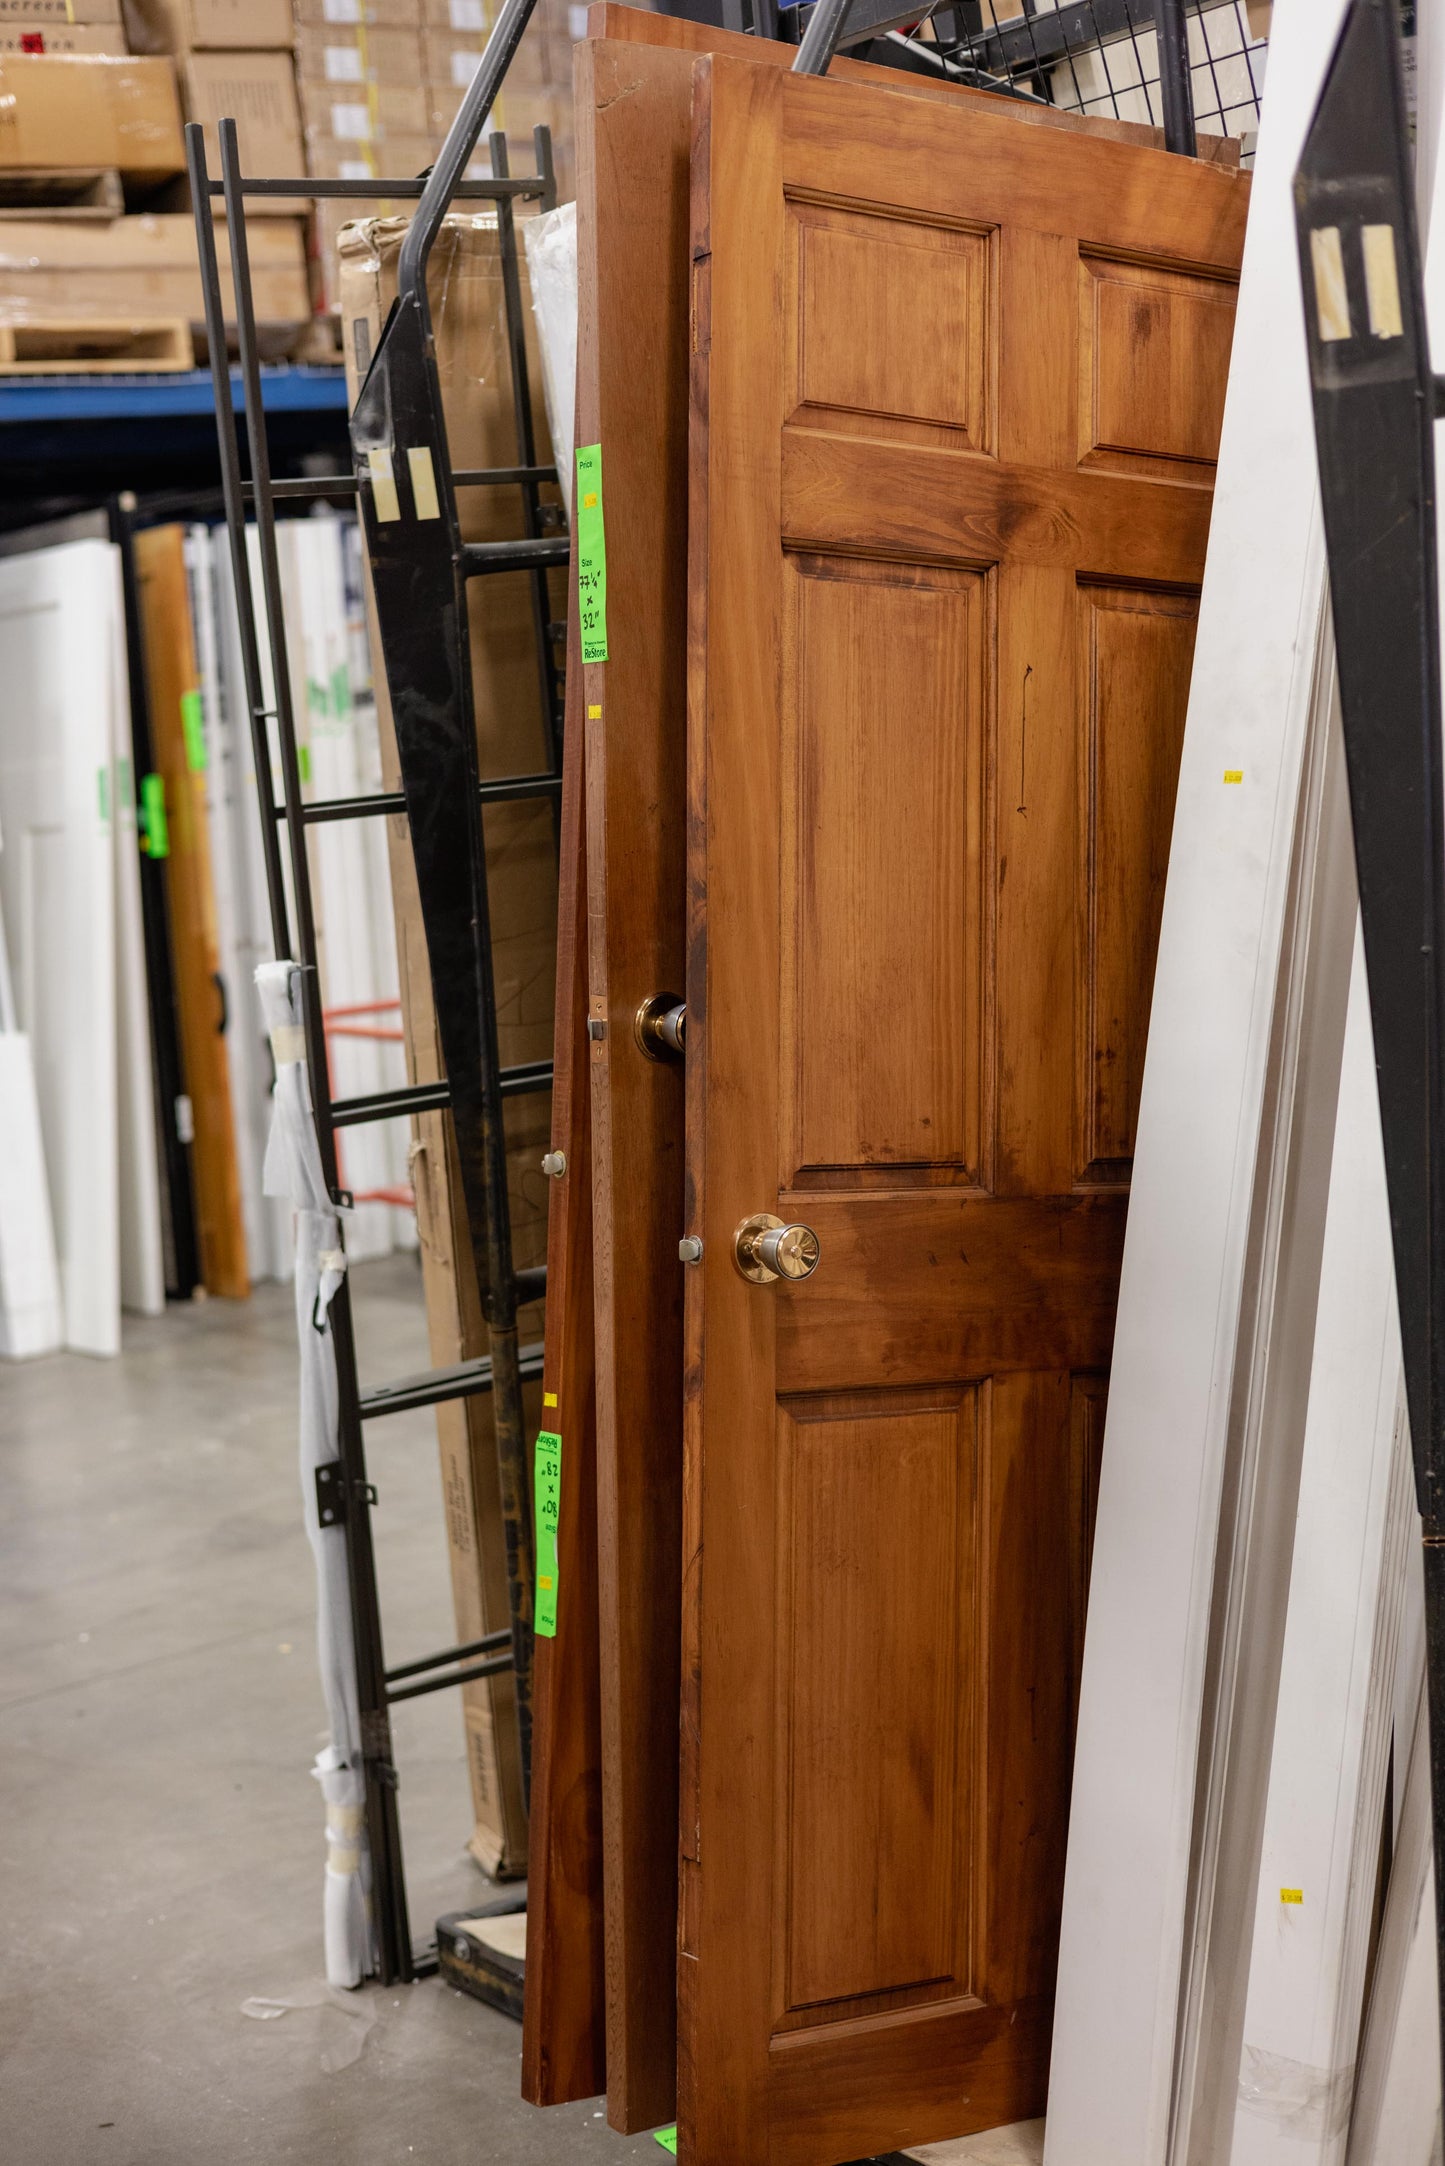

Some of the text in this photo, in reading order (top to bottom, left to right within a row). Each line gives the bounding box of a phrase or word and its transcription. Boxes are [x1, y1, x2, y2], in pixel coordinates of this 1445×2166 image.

[580, 461, 593, 469] Price
[581, 559, 593, 567] Size
[585, 647, 606, 659] ReStore
